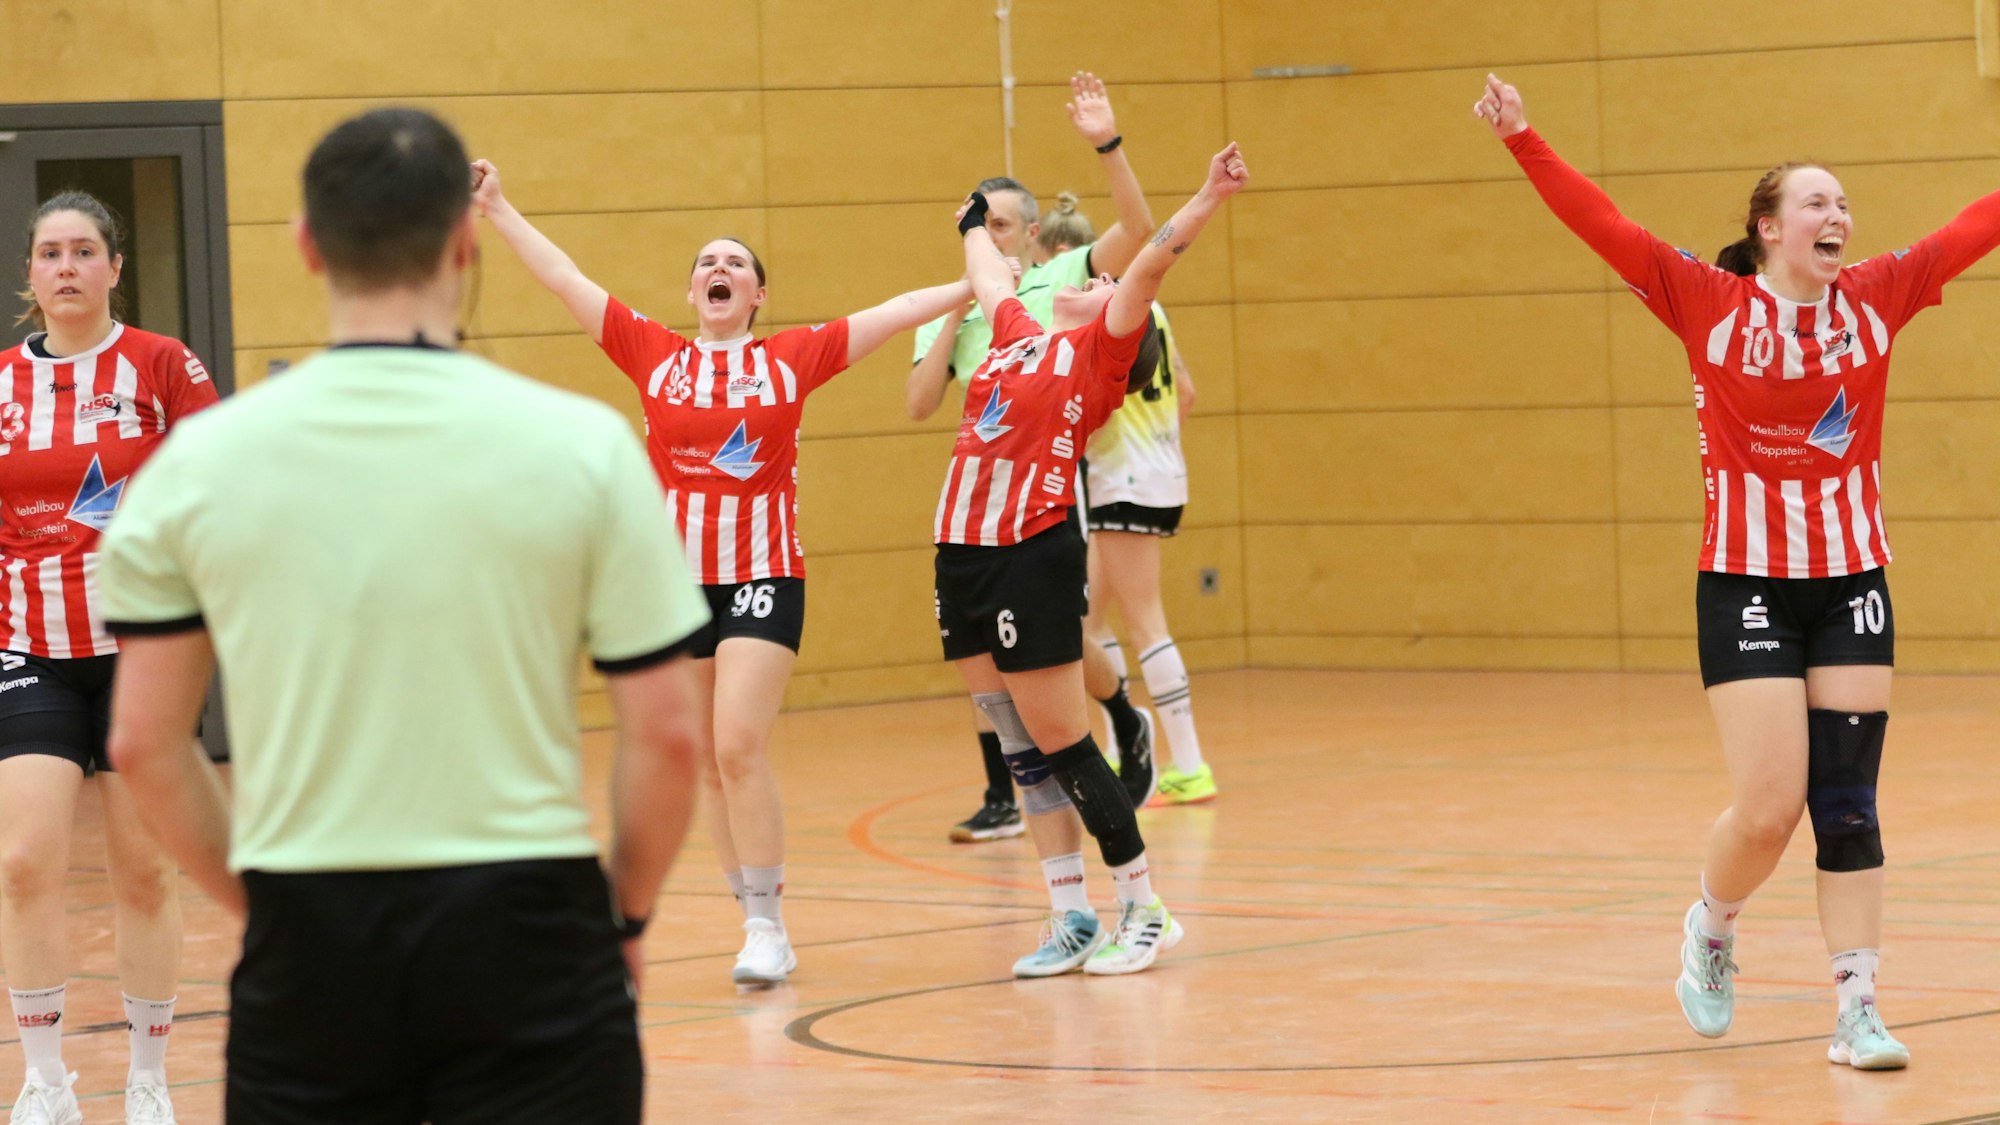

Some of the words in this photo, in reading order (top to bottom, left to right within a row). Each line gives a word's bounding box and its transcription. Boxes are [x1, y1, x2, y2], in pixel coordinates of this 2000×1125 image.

[1741, 326, 1775, 368] 10
[665, 365, 692, 401] 96
[80, 396, 114, 412] HSG
[1749, 424, 1805, 436] Metallbau
[1750, 441, 1807, 459] Kloppstein
[731, 583, 776, 619] 96
[1848, 589, 1885, 635] 10
[997, 609, 1018, 649] 6
[1738, 639, 1780, 652] Kempa
[0, 676, 39, 693] Kempa
[18, 1010, 58, 1023] HSG
[149, 1024, 171, 1035] HS
